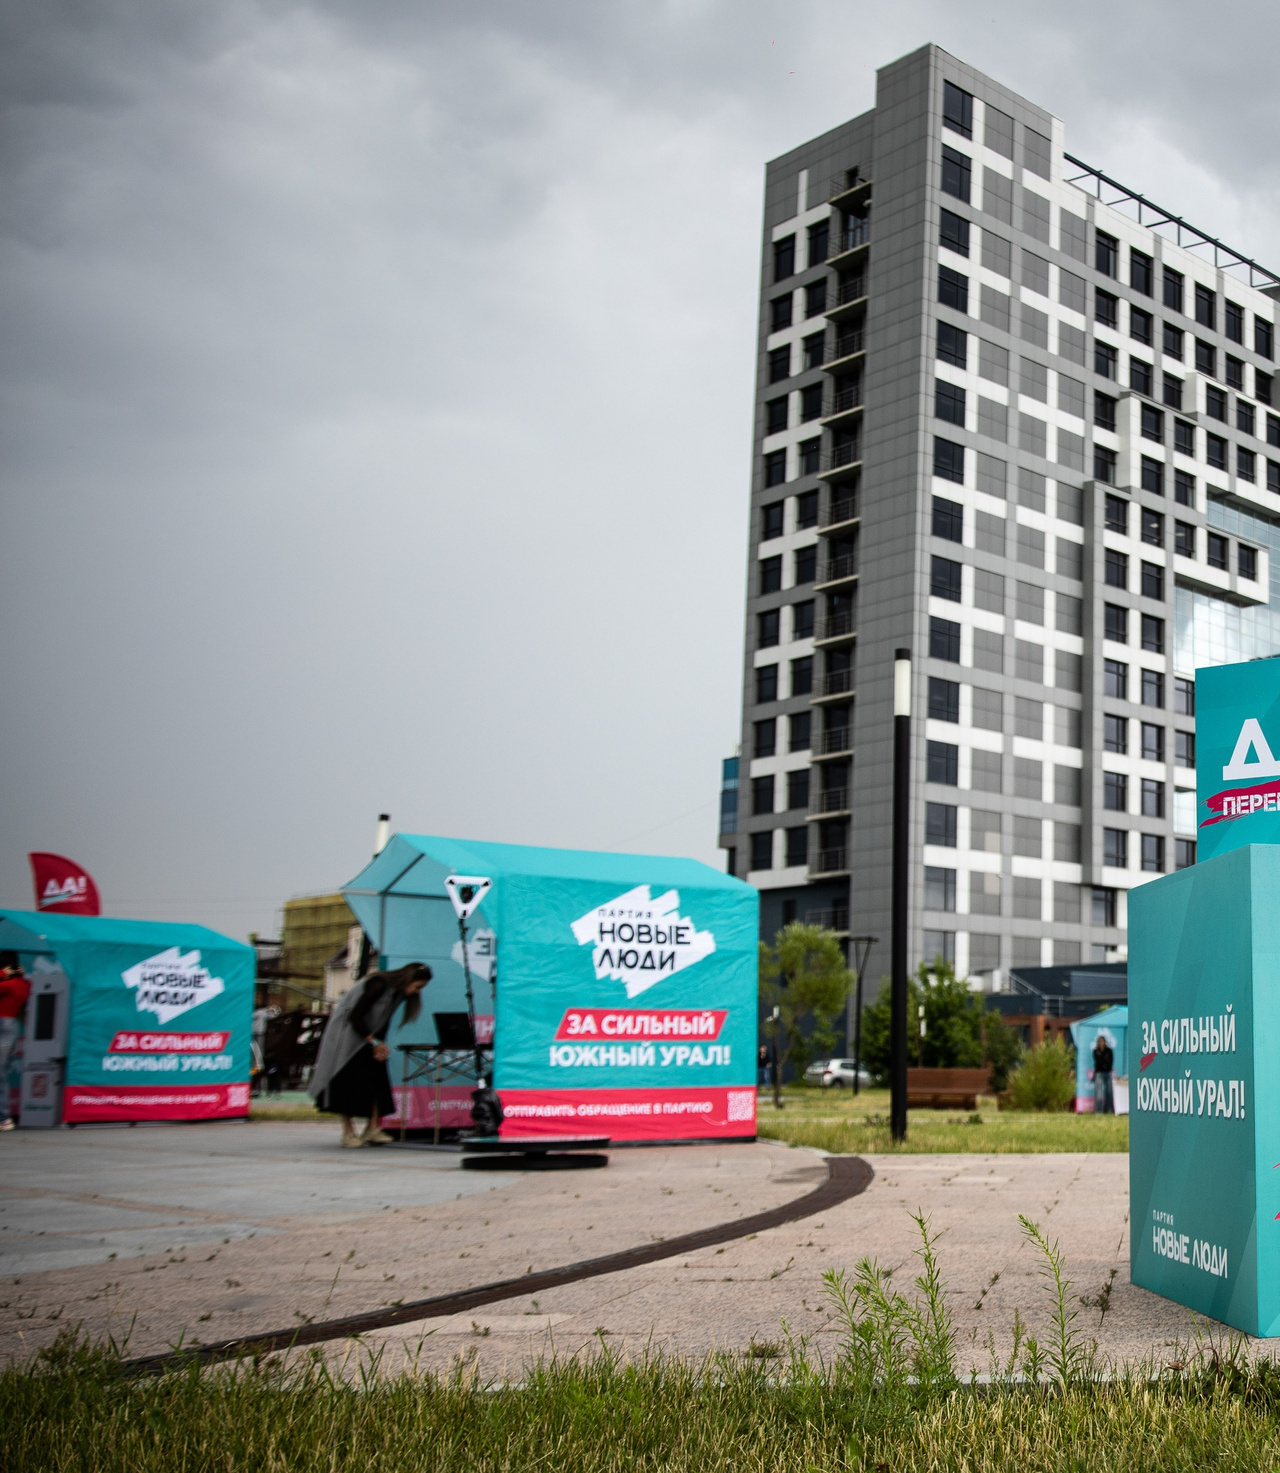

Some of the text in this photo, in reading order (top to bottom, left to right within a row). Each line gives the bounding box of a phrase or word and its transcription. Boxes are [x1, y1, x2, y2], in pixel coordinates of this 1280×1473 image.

[598, 908, 653, 919] ПАРТИЯ
[599, 922, 691, 946] НОВЫЕ
[597, 948, 676, 971] ЛЮДИ
[141, 972, 206, 989] НОВЫЕ
[566, 1011, 716, 1036] ЗА СИЛЬНЫЙ
[1141, 1003, 1236, 1055] ЗА СИЛЬНЫЙ
[114, 1034, 138, 1051] ЗА
[549, 1041, 731, 1068] ЮЖНЫЙ УРАЛ!
[1137, 1069, 1245, 1120] ЮЖНЫЙ УРАЛ!
[503, 1101, 713, 1118] ОТПРАВИТЬ ОБРАЩЕНИЕ В ПАРТИЮ
[1152, 1209, 1174, 1226] ПАРТИЯ
[1152, 1225, 1228, 1279] НОВЫЕ ЛЮДИ
